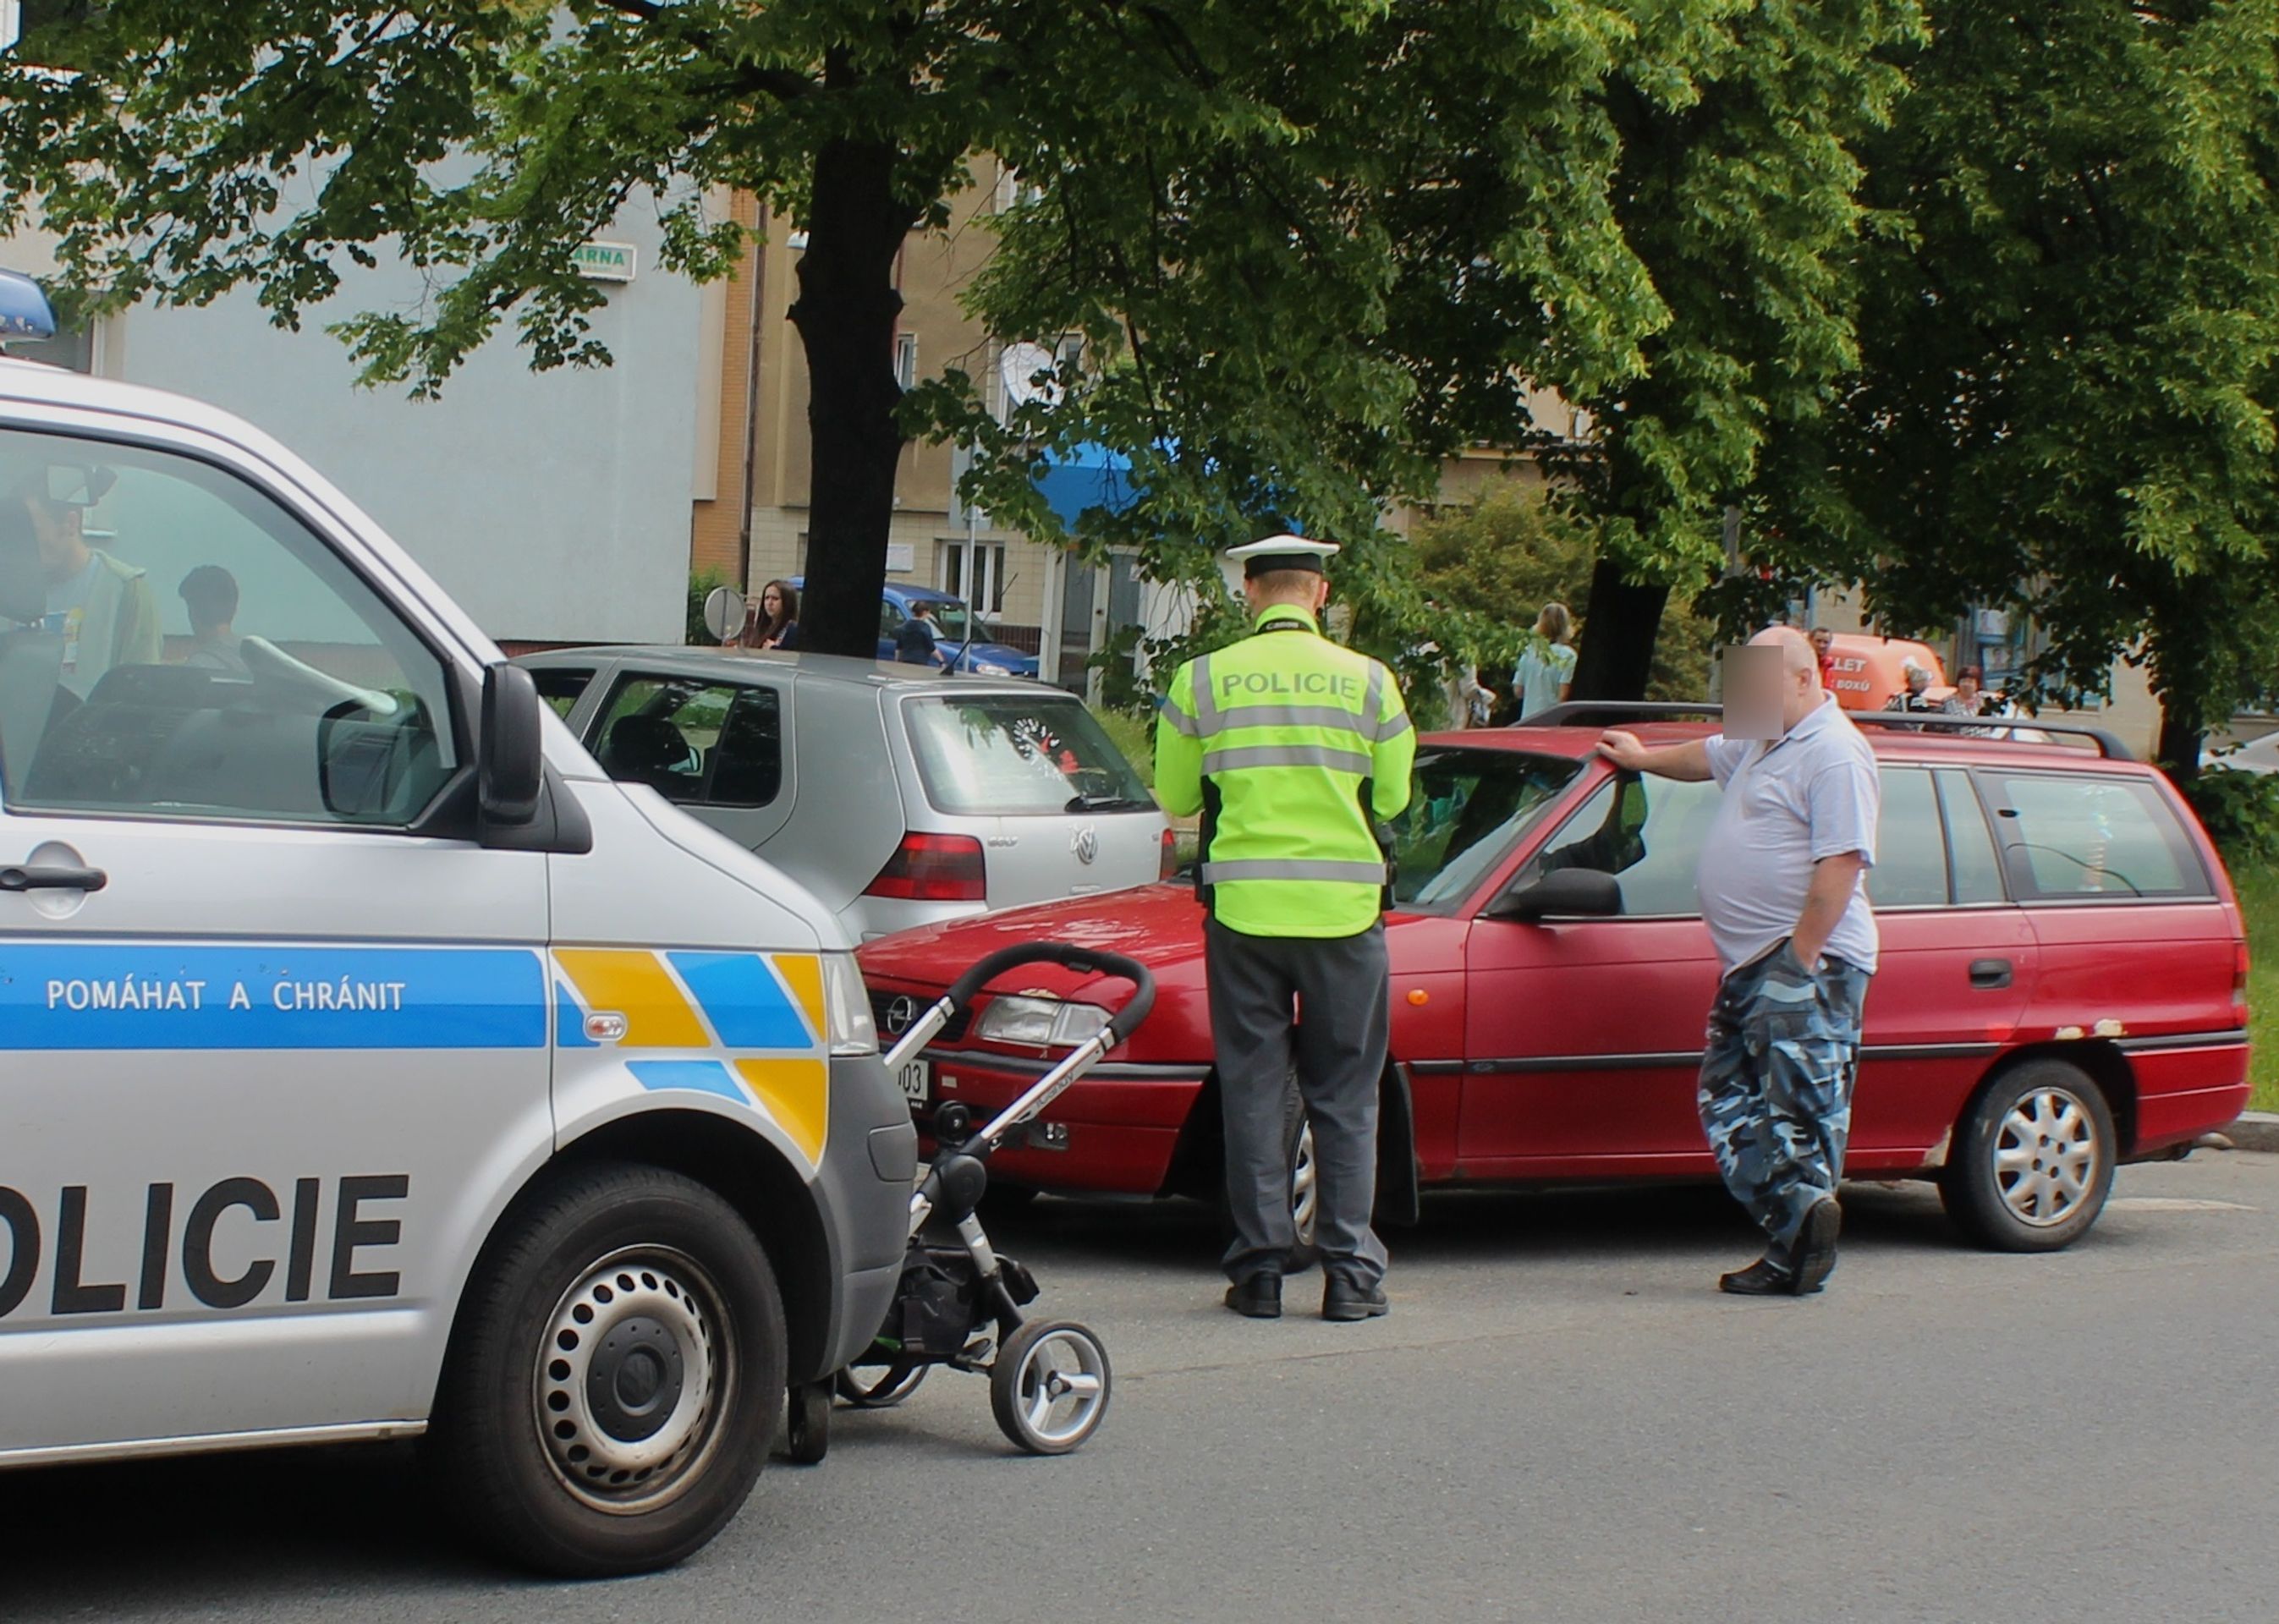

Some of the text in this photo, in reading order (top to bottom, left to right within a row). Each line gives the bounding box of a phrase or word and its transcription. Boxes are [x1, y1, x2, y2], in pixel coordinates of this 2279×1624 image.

[1831, 656, 1867, 672] LET
[1222, 672, 1358, 701] POLICIE
[47, 974, 406, 1012] POMÁHAT A CHRÁNIT
[898, 1063, 922, 1094] 03
